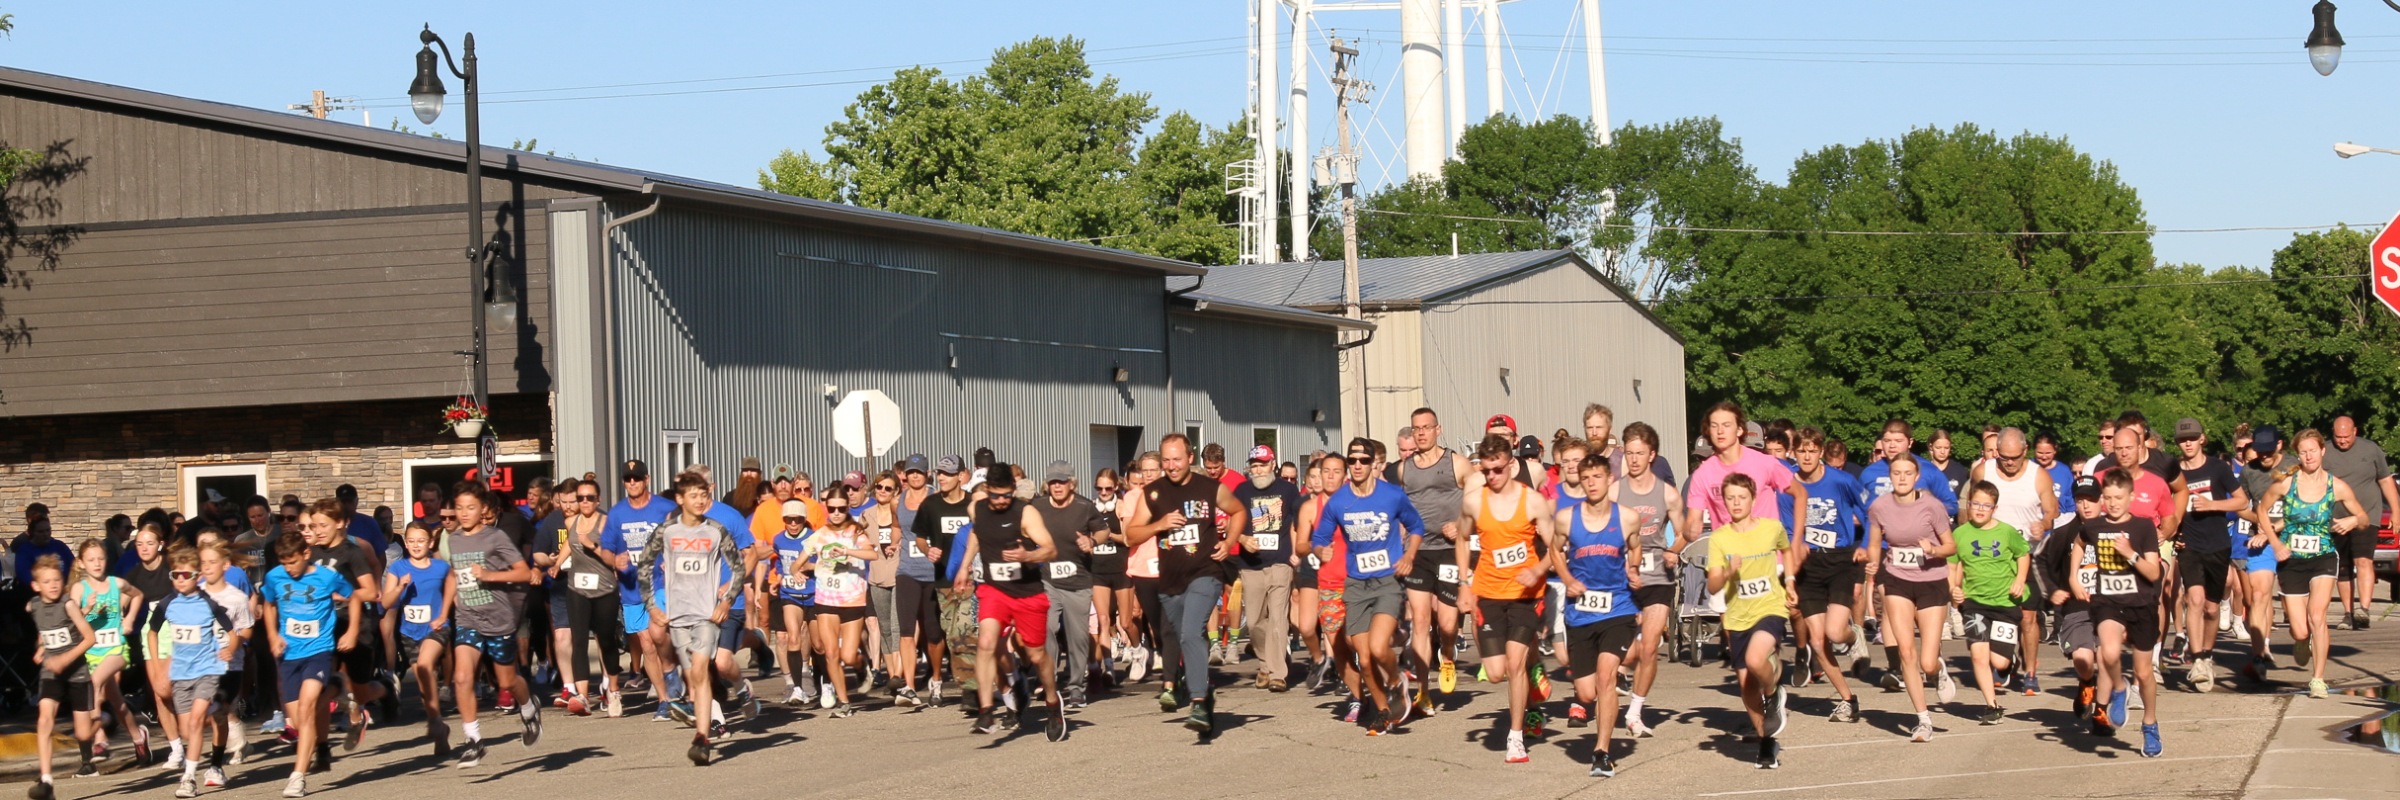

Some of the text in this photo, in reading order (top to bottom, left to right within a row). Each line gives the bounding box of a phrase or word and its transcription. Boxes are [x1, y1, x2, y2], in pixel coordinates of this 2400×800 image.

[1184, 500, 1209, 518] USA
[948, 520, 963, 531] 59
[878, 531, 892, 541] 58
[1170, 528, 1196, 542] 121
[1812, 531, 1829, 544] 20
[671, 538, 713, 552] FXR
[2294, 538, 2317, 549] 127
[1360, 554, 1386, 569] 189
[1497, 547, 1526, 565] 166
[1899, 551, 1917, 563] 22
[683, 560, 701, 572] 60
[996, 566, 1014, 577] 45
[1055, 564, 1071, 575] 80
[456, 572, 477, 585] 18
[582, 576, 589, 586] 5
[826, 576, 841, 589] 88
[2081, 572, 2097, 584] 84
[1739, 579, 1769, 596] 182
[2105, 578, 2134, 592] 102
[1579, 593, 1608, 609] 181
[408, 608, 424, 620] 37
[175, 628, 194, 640] 57
[293, 623, 311, 635] 89
[1996, 626, 2015, 640] 93
[42, 631, 68, 646] 178
[94, 631, 115, 644] 77
